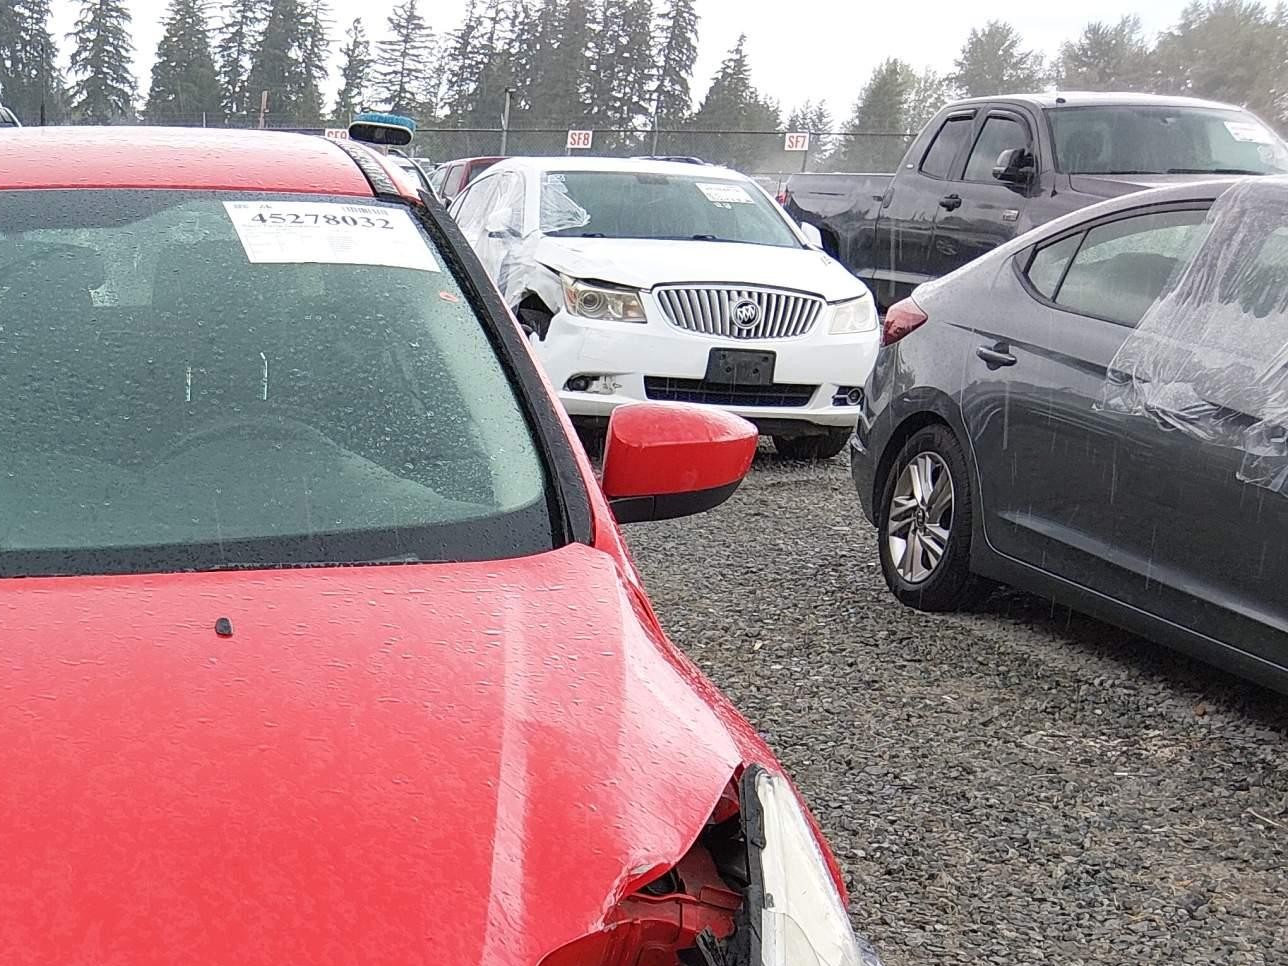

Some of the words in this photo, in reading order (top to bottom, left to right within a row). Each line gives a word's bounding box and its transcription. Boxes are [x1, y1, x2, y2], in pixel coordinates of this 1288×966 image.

[570, 132, 590, 146] SF8
[788, 135, 807, 149] SF7
[251, 213, 394, 230] 45278032
